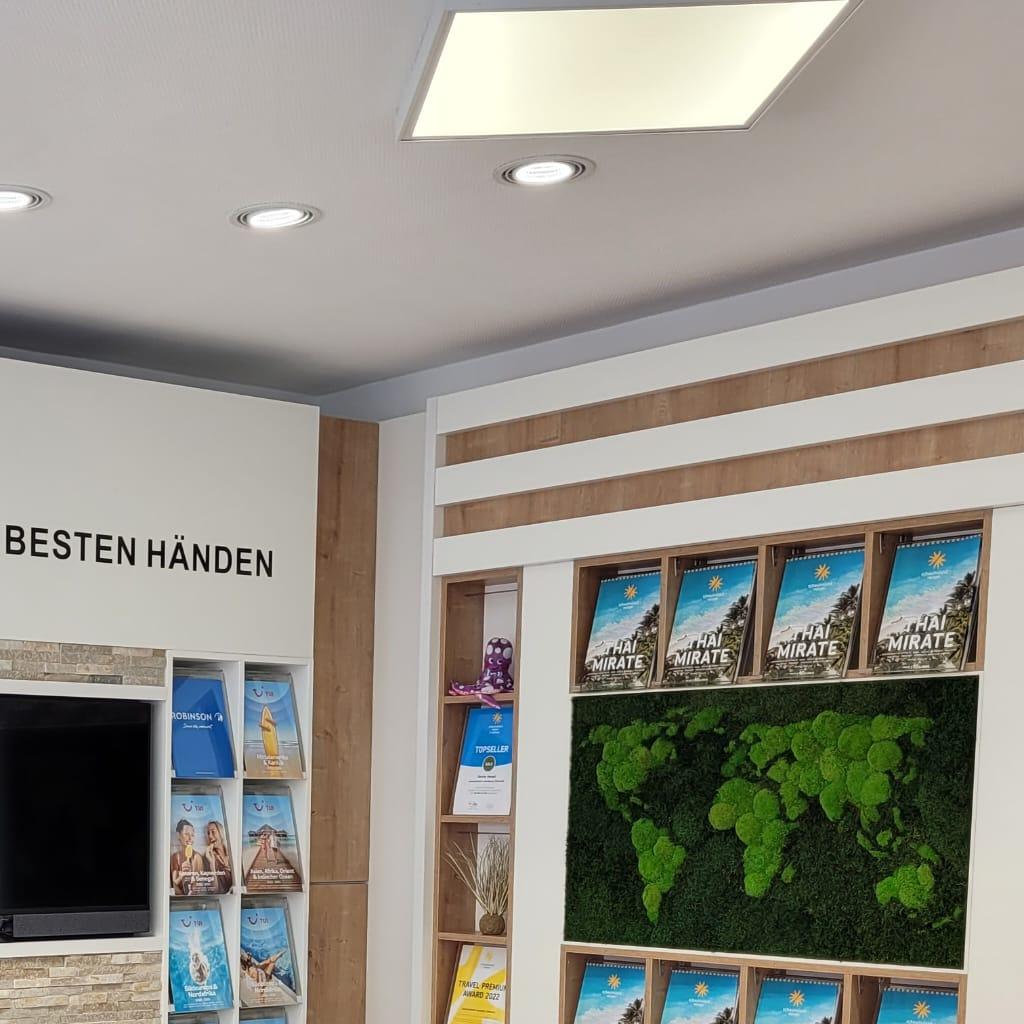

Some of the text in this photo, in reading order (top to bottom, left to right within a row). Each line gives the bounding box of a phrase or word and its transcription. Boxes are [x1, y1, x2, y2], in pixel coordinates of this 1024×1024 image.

[5, 525, 136, 565] BESTEN
[147, 535, 274, 577] HÄNDEN
[777, 640, 839, 659] MIRATE
[888, 631, 956, 651] MIRATE
[592, 655, 644, 672] MIRATE
[674, 649, 729, 666] MIRATE
[475, 745, 509, 753] TOPSELLER
[458, 980, 479, 989] TRAVEL
[463, 990, 484, 998] AWARD
